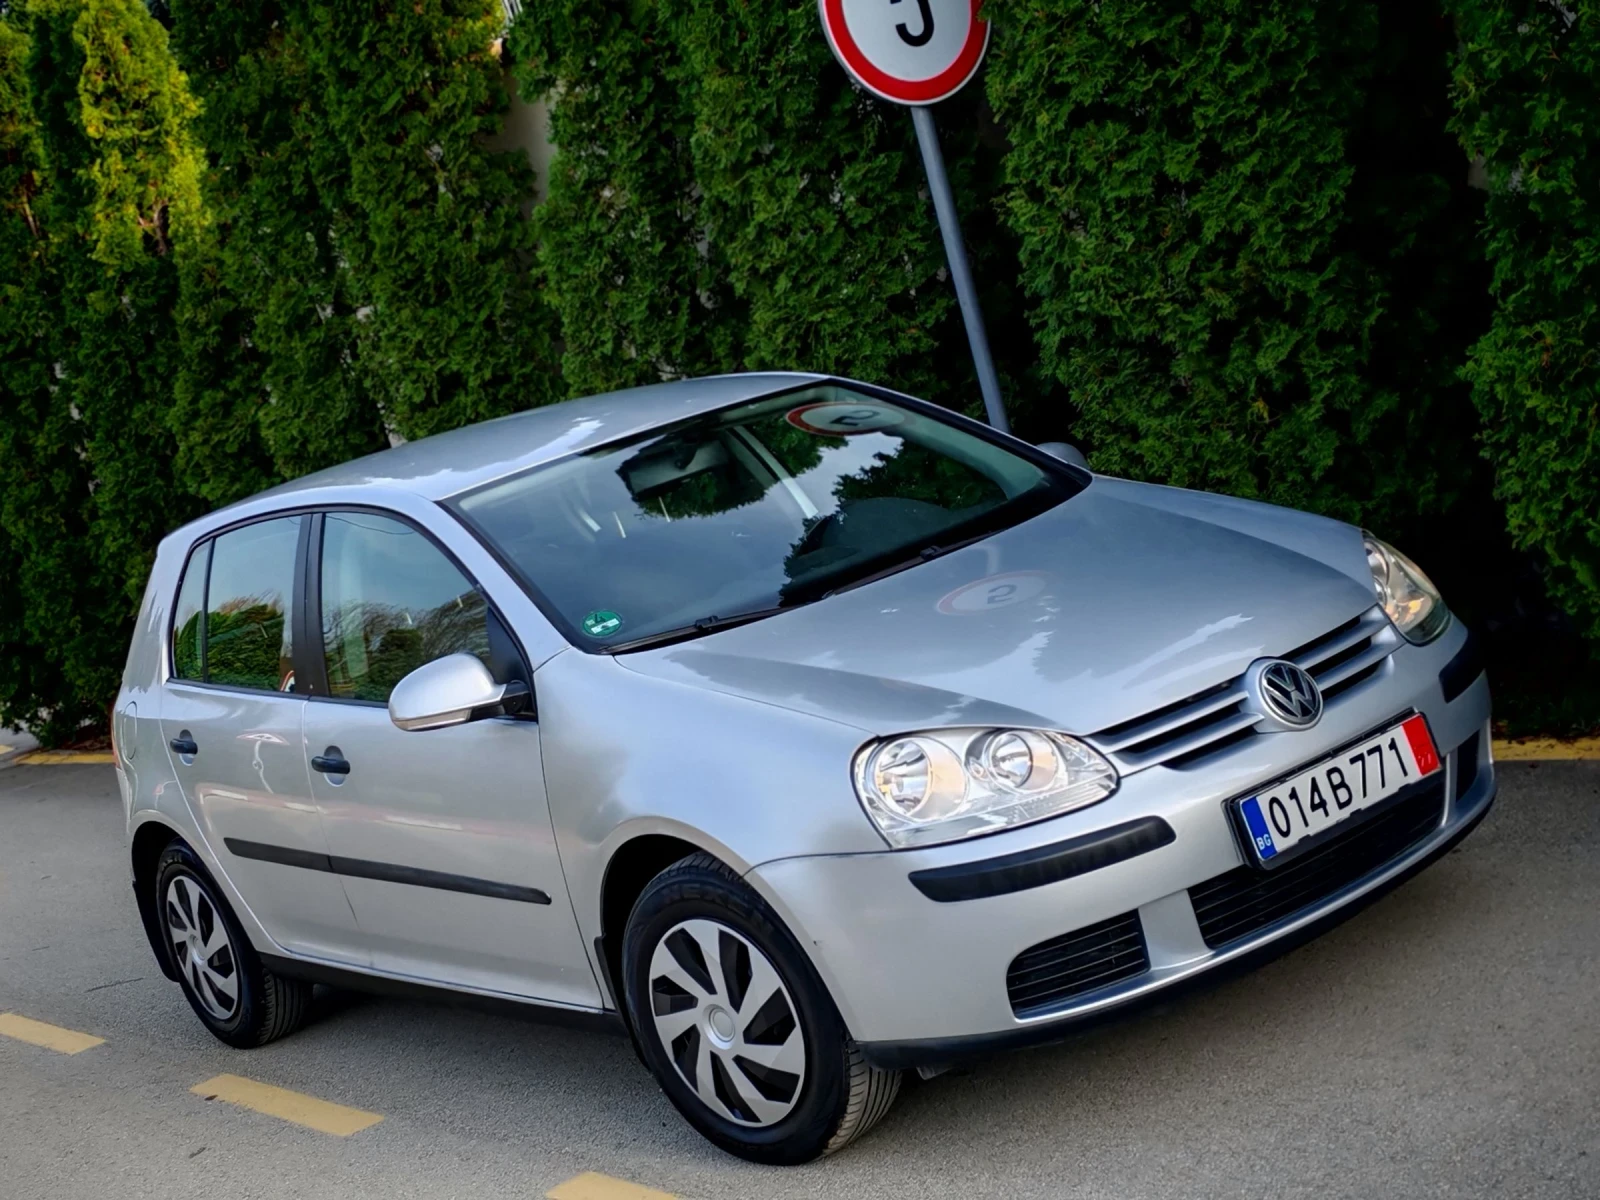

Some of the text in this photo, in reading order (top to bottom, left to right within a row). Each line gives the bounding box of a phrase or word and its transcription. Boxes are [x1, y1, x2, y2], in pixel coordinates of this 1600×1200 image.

[1262, 662, 1318, 720] VW
[1268, 737, 1408, 838] 014B771
[1256, 833, 1272, 850] BG
